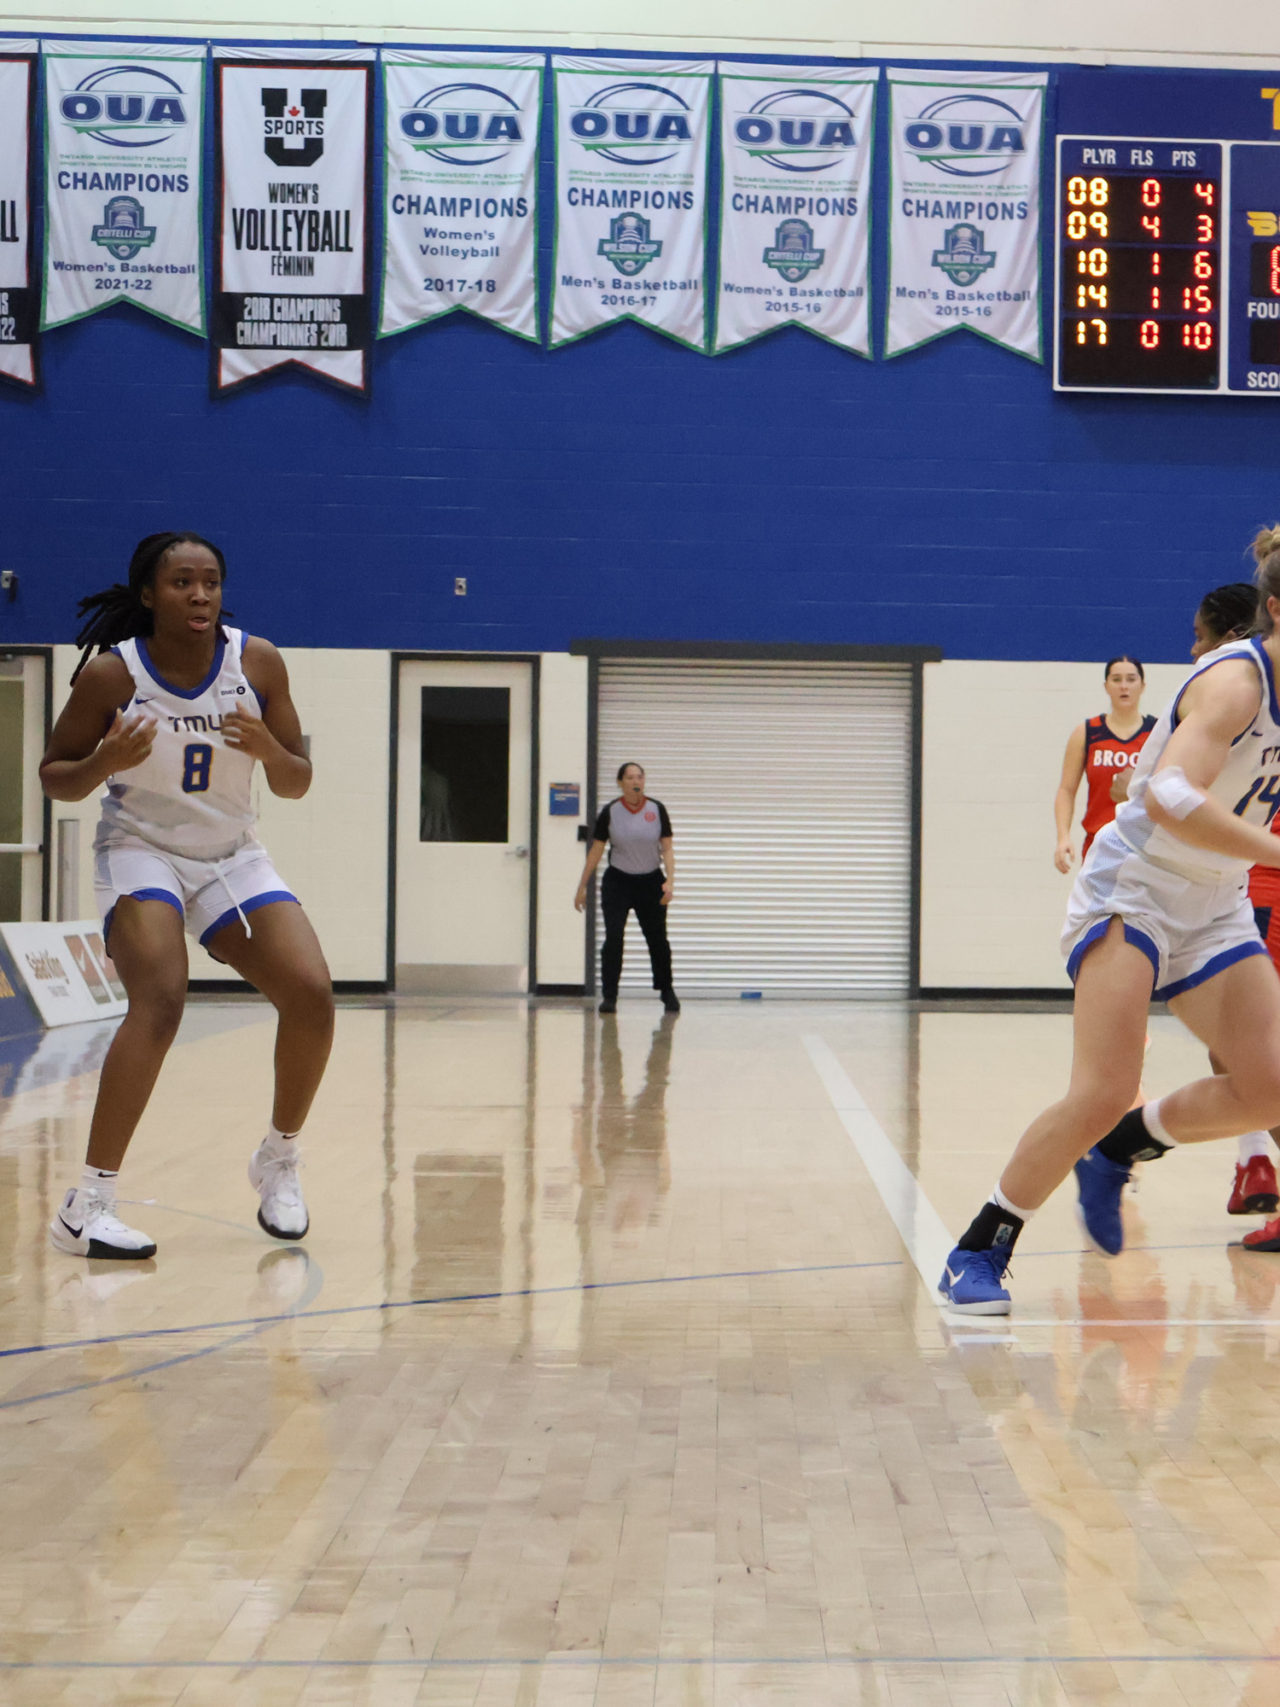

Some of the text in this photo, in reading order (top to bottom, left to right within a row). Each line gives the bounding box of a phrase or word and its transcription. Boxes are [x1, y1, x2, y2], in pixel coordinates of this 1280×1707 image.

[60, 94, 188, 123] OUA
[264, 120, 324, 135] SPORTS
[400, 111, 523, 141] OUA
[571, 111, 694, 141] OUA
[736, 118, 856, 147] OUA
[905, 123, 1025, 151] OUA
[1083, 148, 1196, 167] PLYR FLS PTS
[58, 171, 189, 193] CHAMPIONS
[1067, 176, 1213, 207] 08 0 4
[268, 183, 319, 204] WOMEN'S
[568, 187, 694, 209] CHAMPIONS
[732, 193, 858, 216] CHAMPIONS
[392, 194, 528, 219] CHAMPIONS
[902, 198, 1028, 220] CHAMPIONS
[232, 208, 353, 252] VOLLEYBALL
[424, 228, 495, 241] Women's
[1067, 211, 1212, 242] 09 4 3
[271, 251, 314, 276] FÉMININ
[420, 245, 499, 260] Volleyball
[1078, 248, 1212, 279] 10 1 6
[53, 261, 195, 274] Women's Basketball
[95, 279, 152, 290] 2021-22
[424, 278, 496, 293] 2017-18
[562, 275, 697, 291] Men's Basketball
[724, 283, 863, 298] Women's Basketball
[896, 286, 1031, 302] Men's Basketball
[244, 297, 341, 321] 2018 CHAMPIONS
[601, 294, 657, 306] 2016-17
[765, 301, 821, 313] 2015-16
[1077, 284, 1212, 313] 14 1 15
[935, 305, 992, 317] 2015-16
[1077, 318, 1212, 349] 17 0 10
[168, 713, 222, 733] TMU
[182, 743, 214, 793] 8
[1093, 749, 1141, 768] BROC
